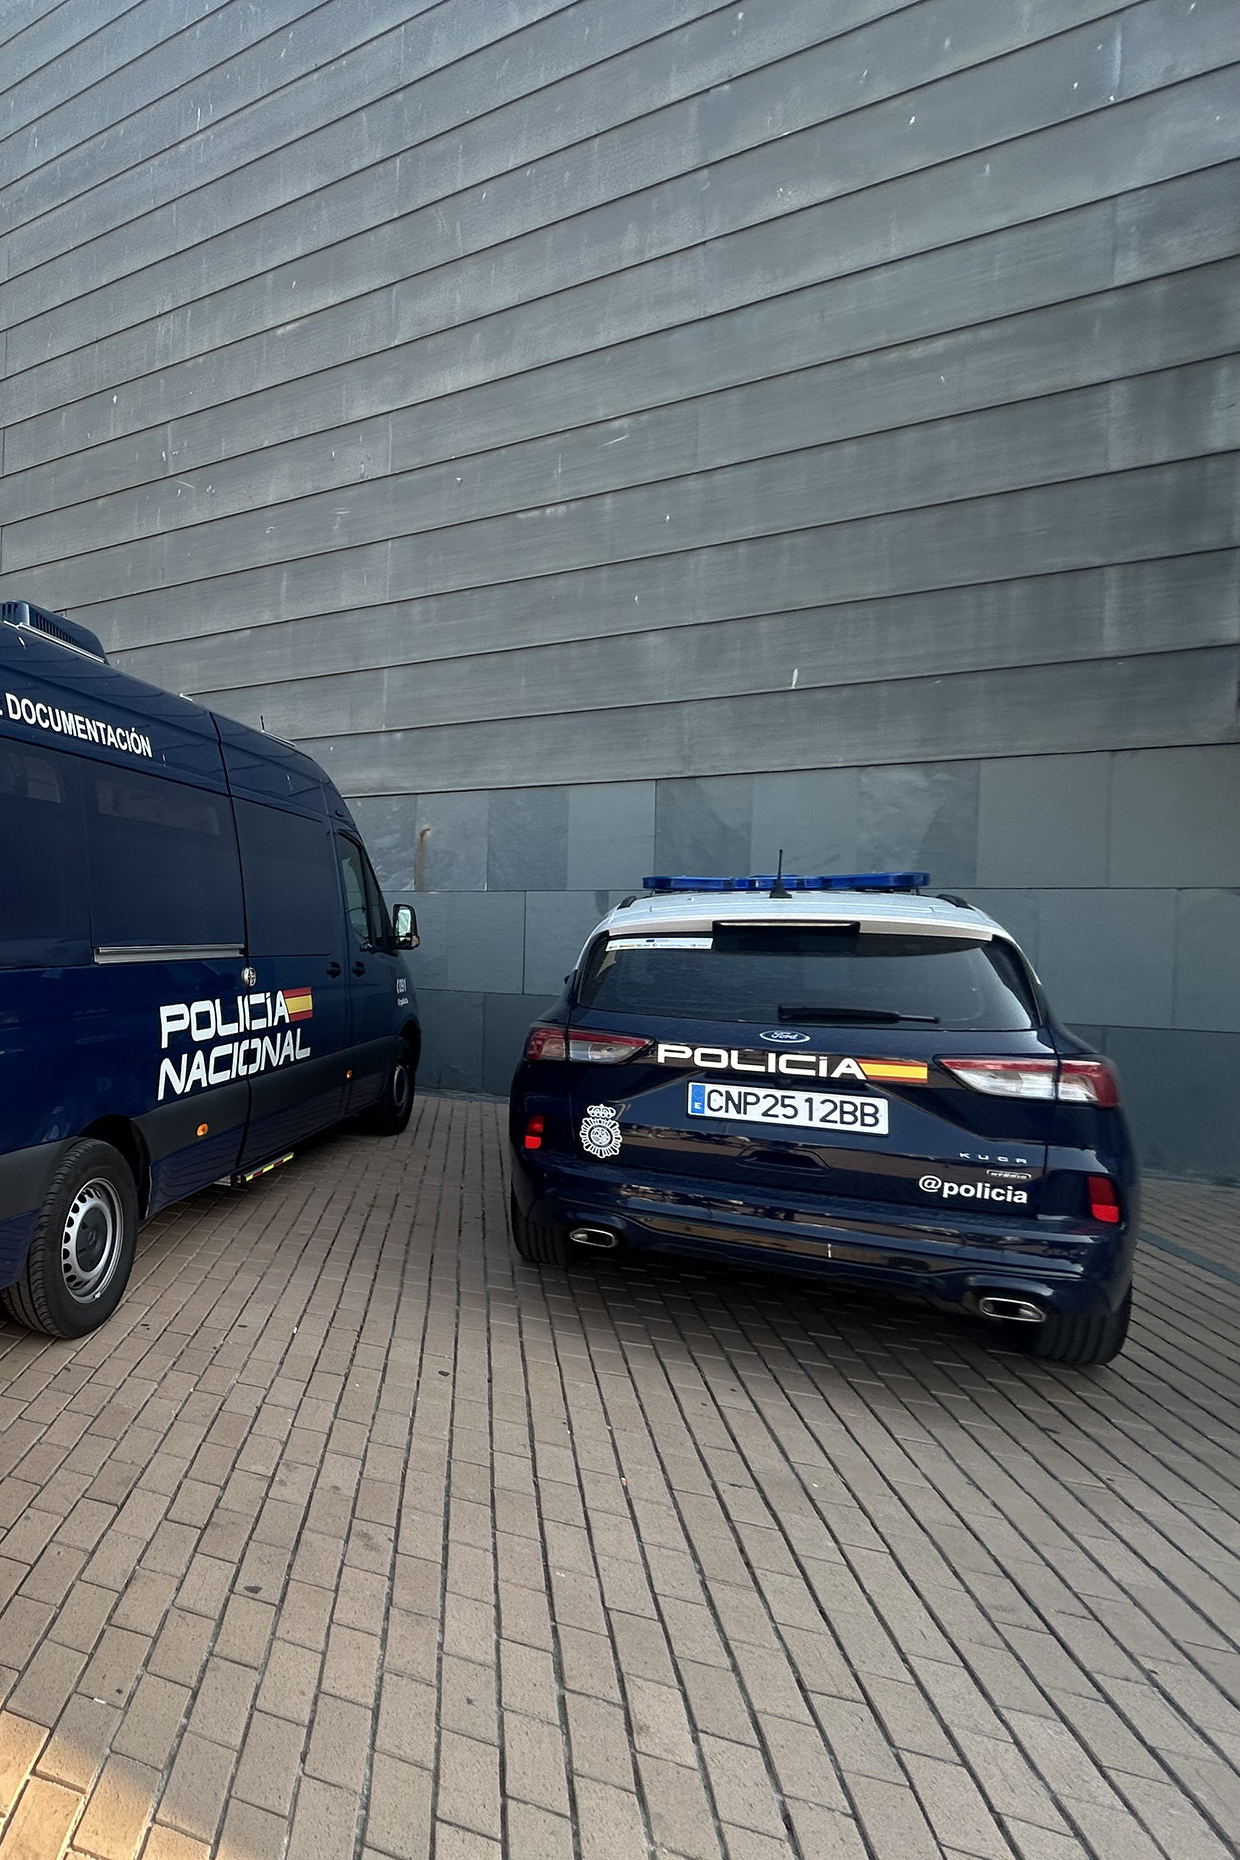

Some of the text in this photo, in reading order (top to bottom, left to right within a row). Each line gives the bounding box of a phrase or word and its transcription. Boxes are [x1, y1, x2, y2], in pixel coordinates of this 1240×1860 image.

[6, 691, 153, 759] DOCUMENTACIÓN
[157, 1028, 312, 1101] NACIONAL
[693, 1101, 702, 1111] E
[705, 1088, 881, 1128] CNP2512BB
[918, 1175, 1029, 1204] @policia
